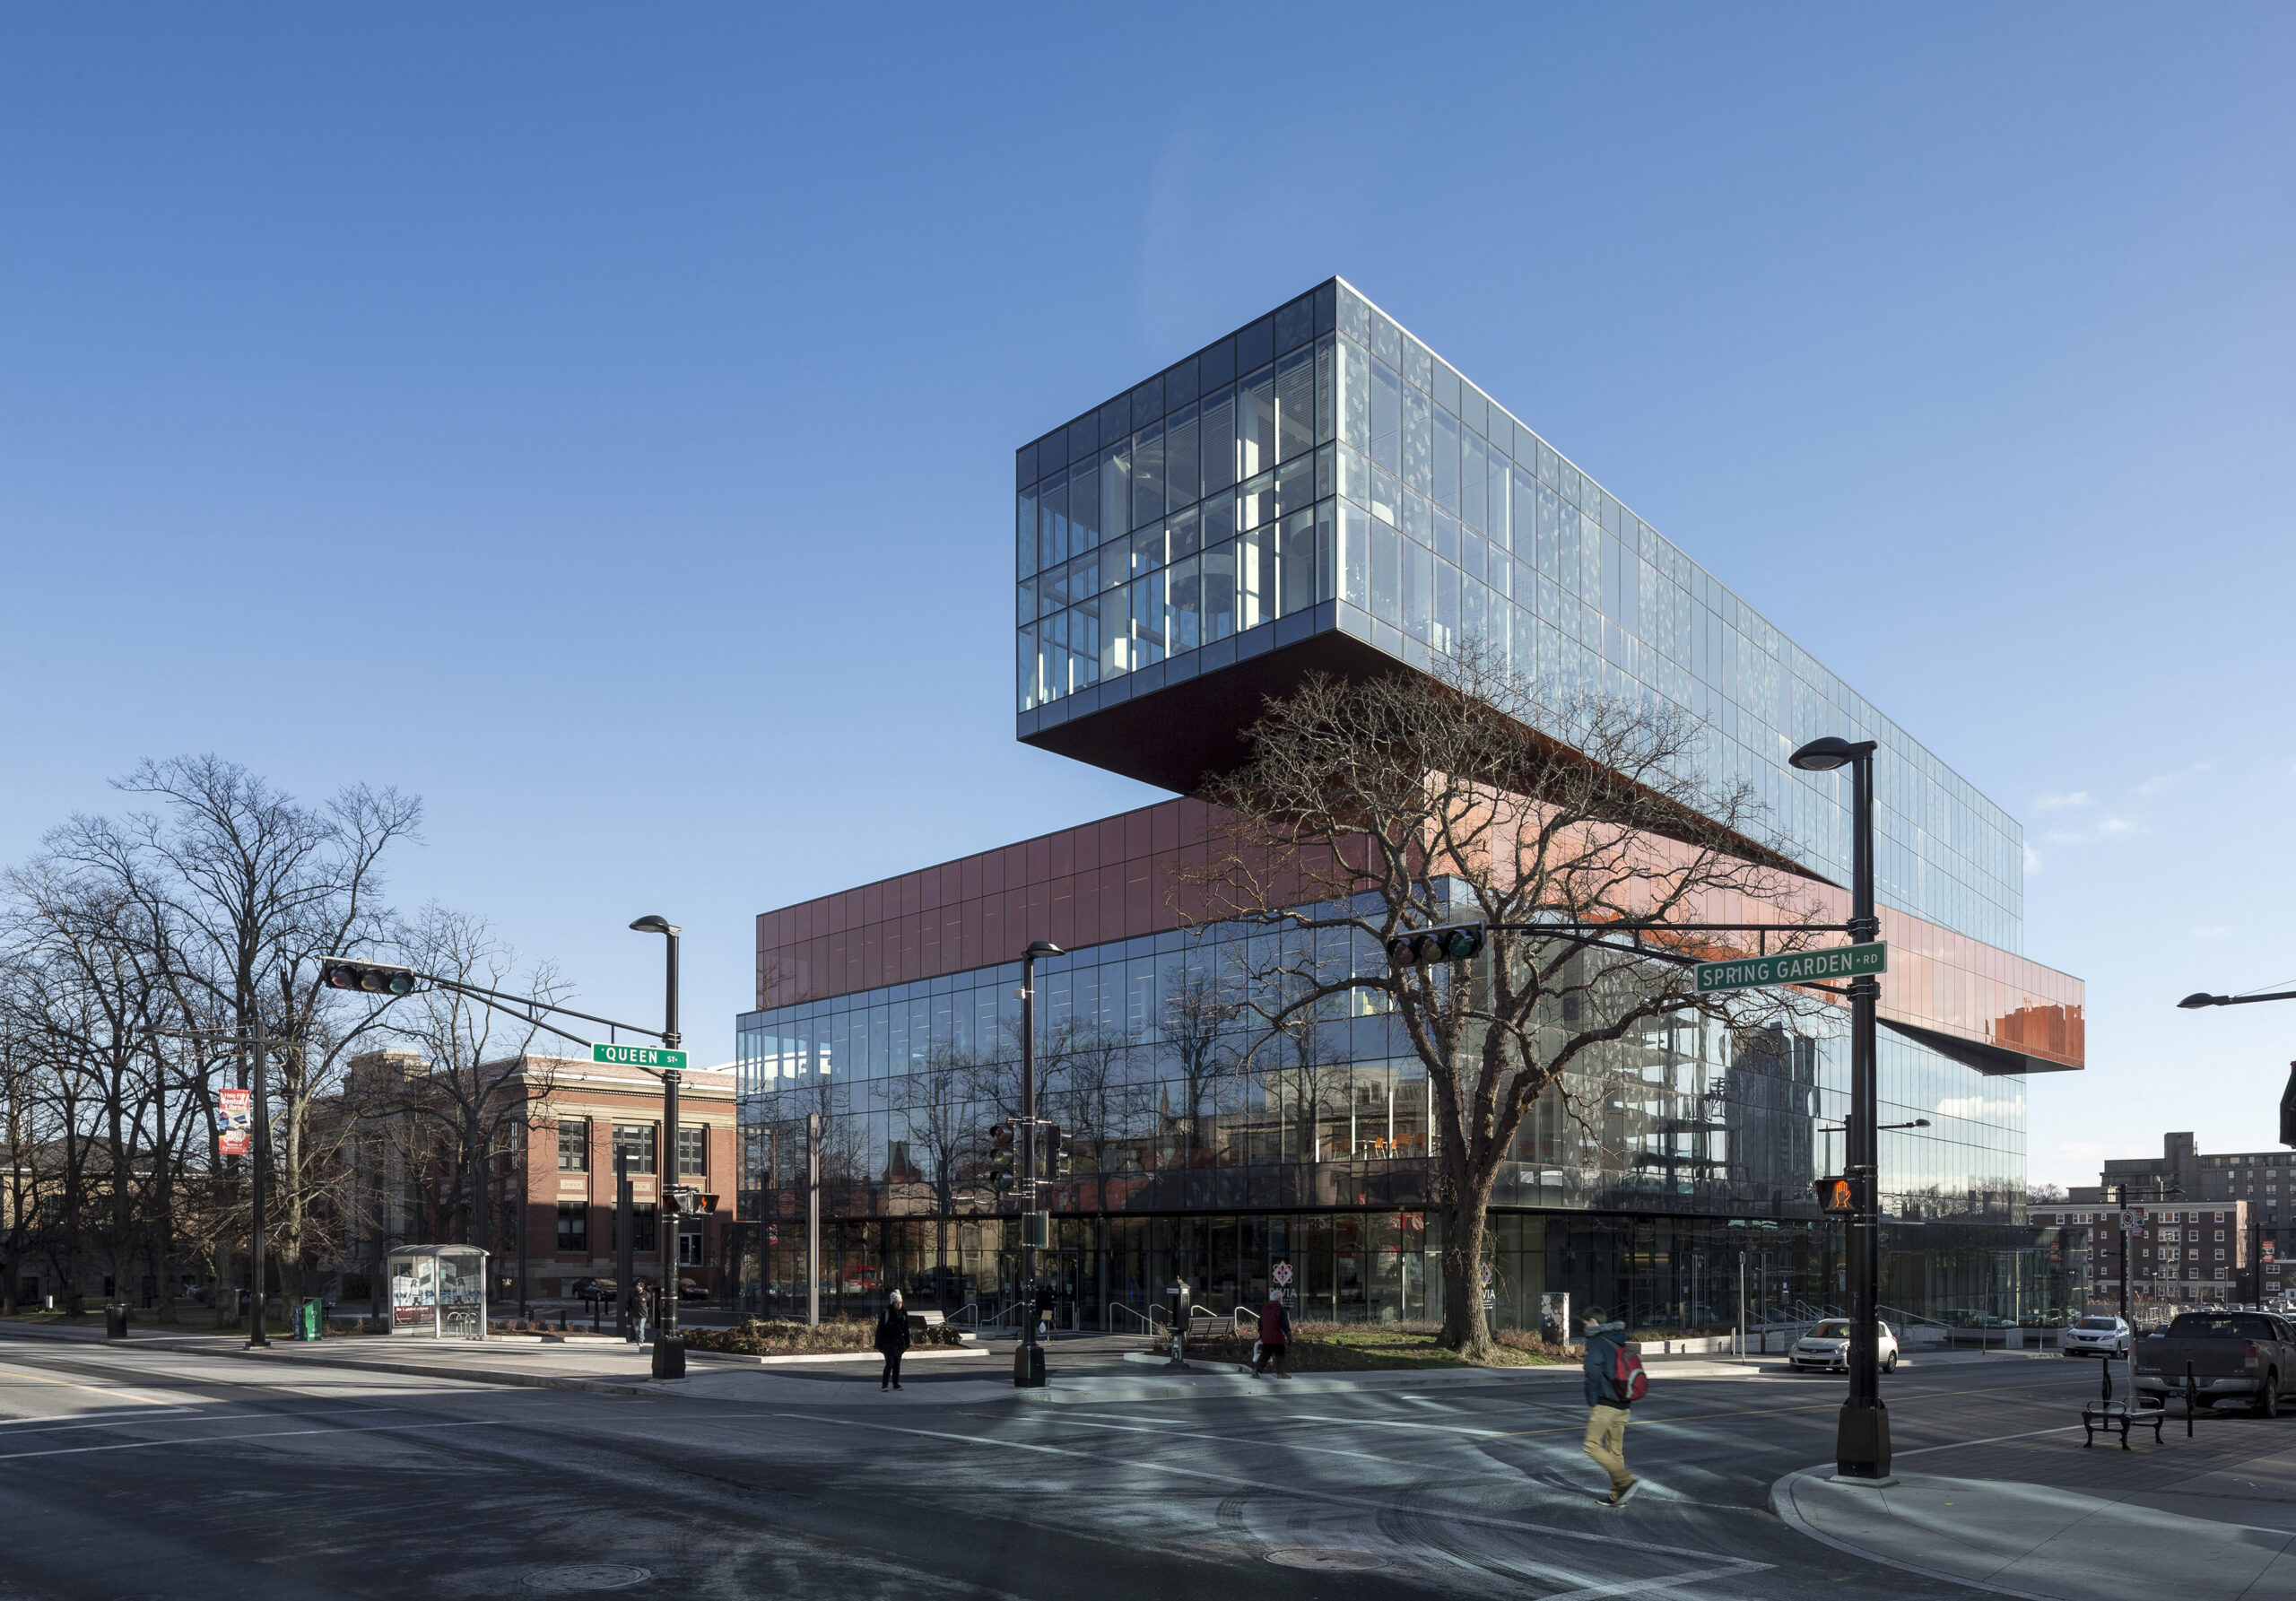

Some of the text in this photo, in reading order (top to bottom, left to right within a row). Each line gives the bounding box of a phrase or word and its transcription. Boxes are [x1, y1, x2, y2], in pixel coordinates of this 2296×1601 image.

[1702, 953, 1878, 987] SPRING GARDEN RD
[605, 1047, 658, 1065] QUEEN
[1481, 1289, 1496, 1299] VIA
